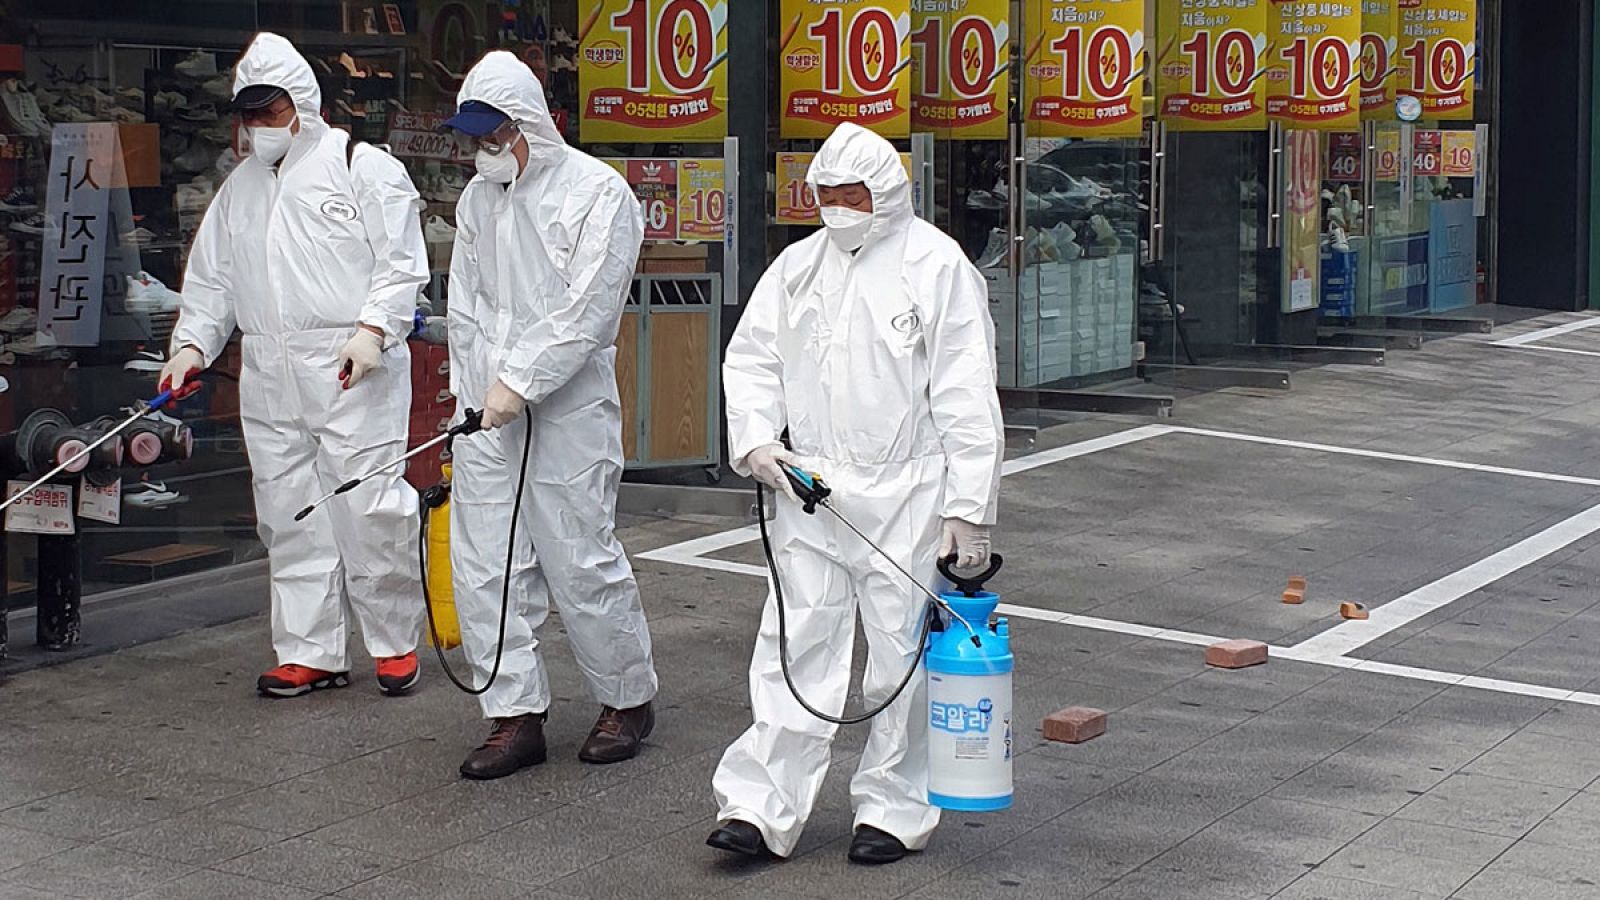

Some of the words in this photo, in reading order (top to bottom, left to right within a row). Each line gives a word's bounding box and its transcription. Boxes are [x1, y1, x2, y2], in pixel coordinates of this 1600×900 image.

[585, 48, 624, 61] 학생할인
[669, 98, 708, 117] 추가할인
[932, 704, 986, 729] 코알라
